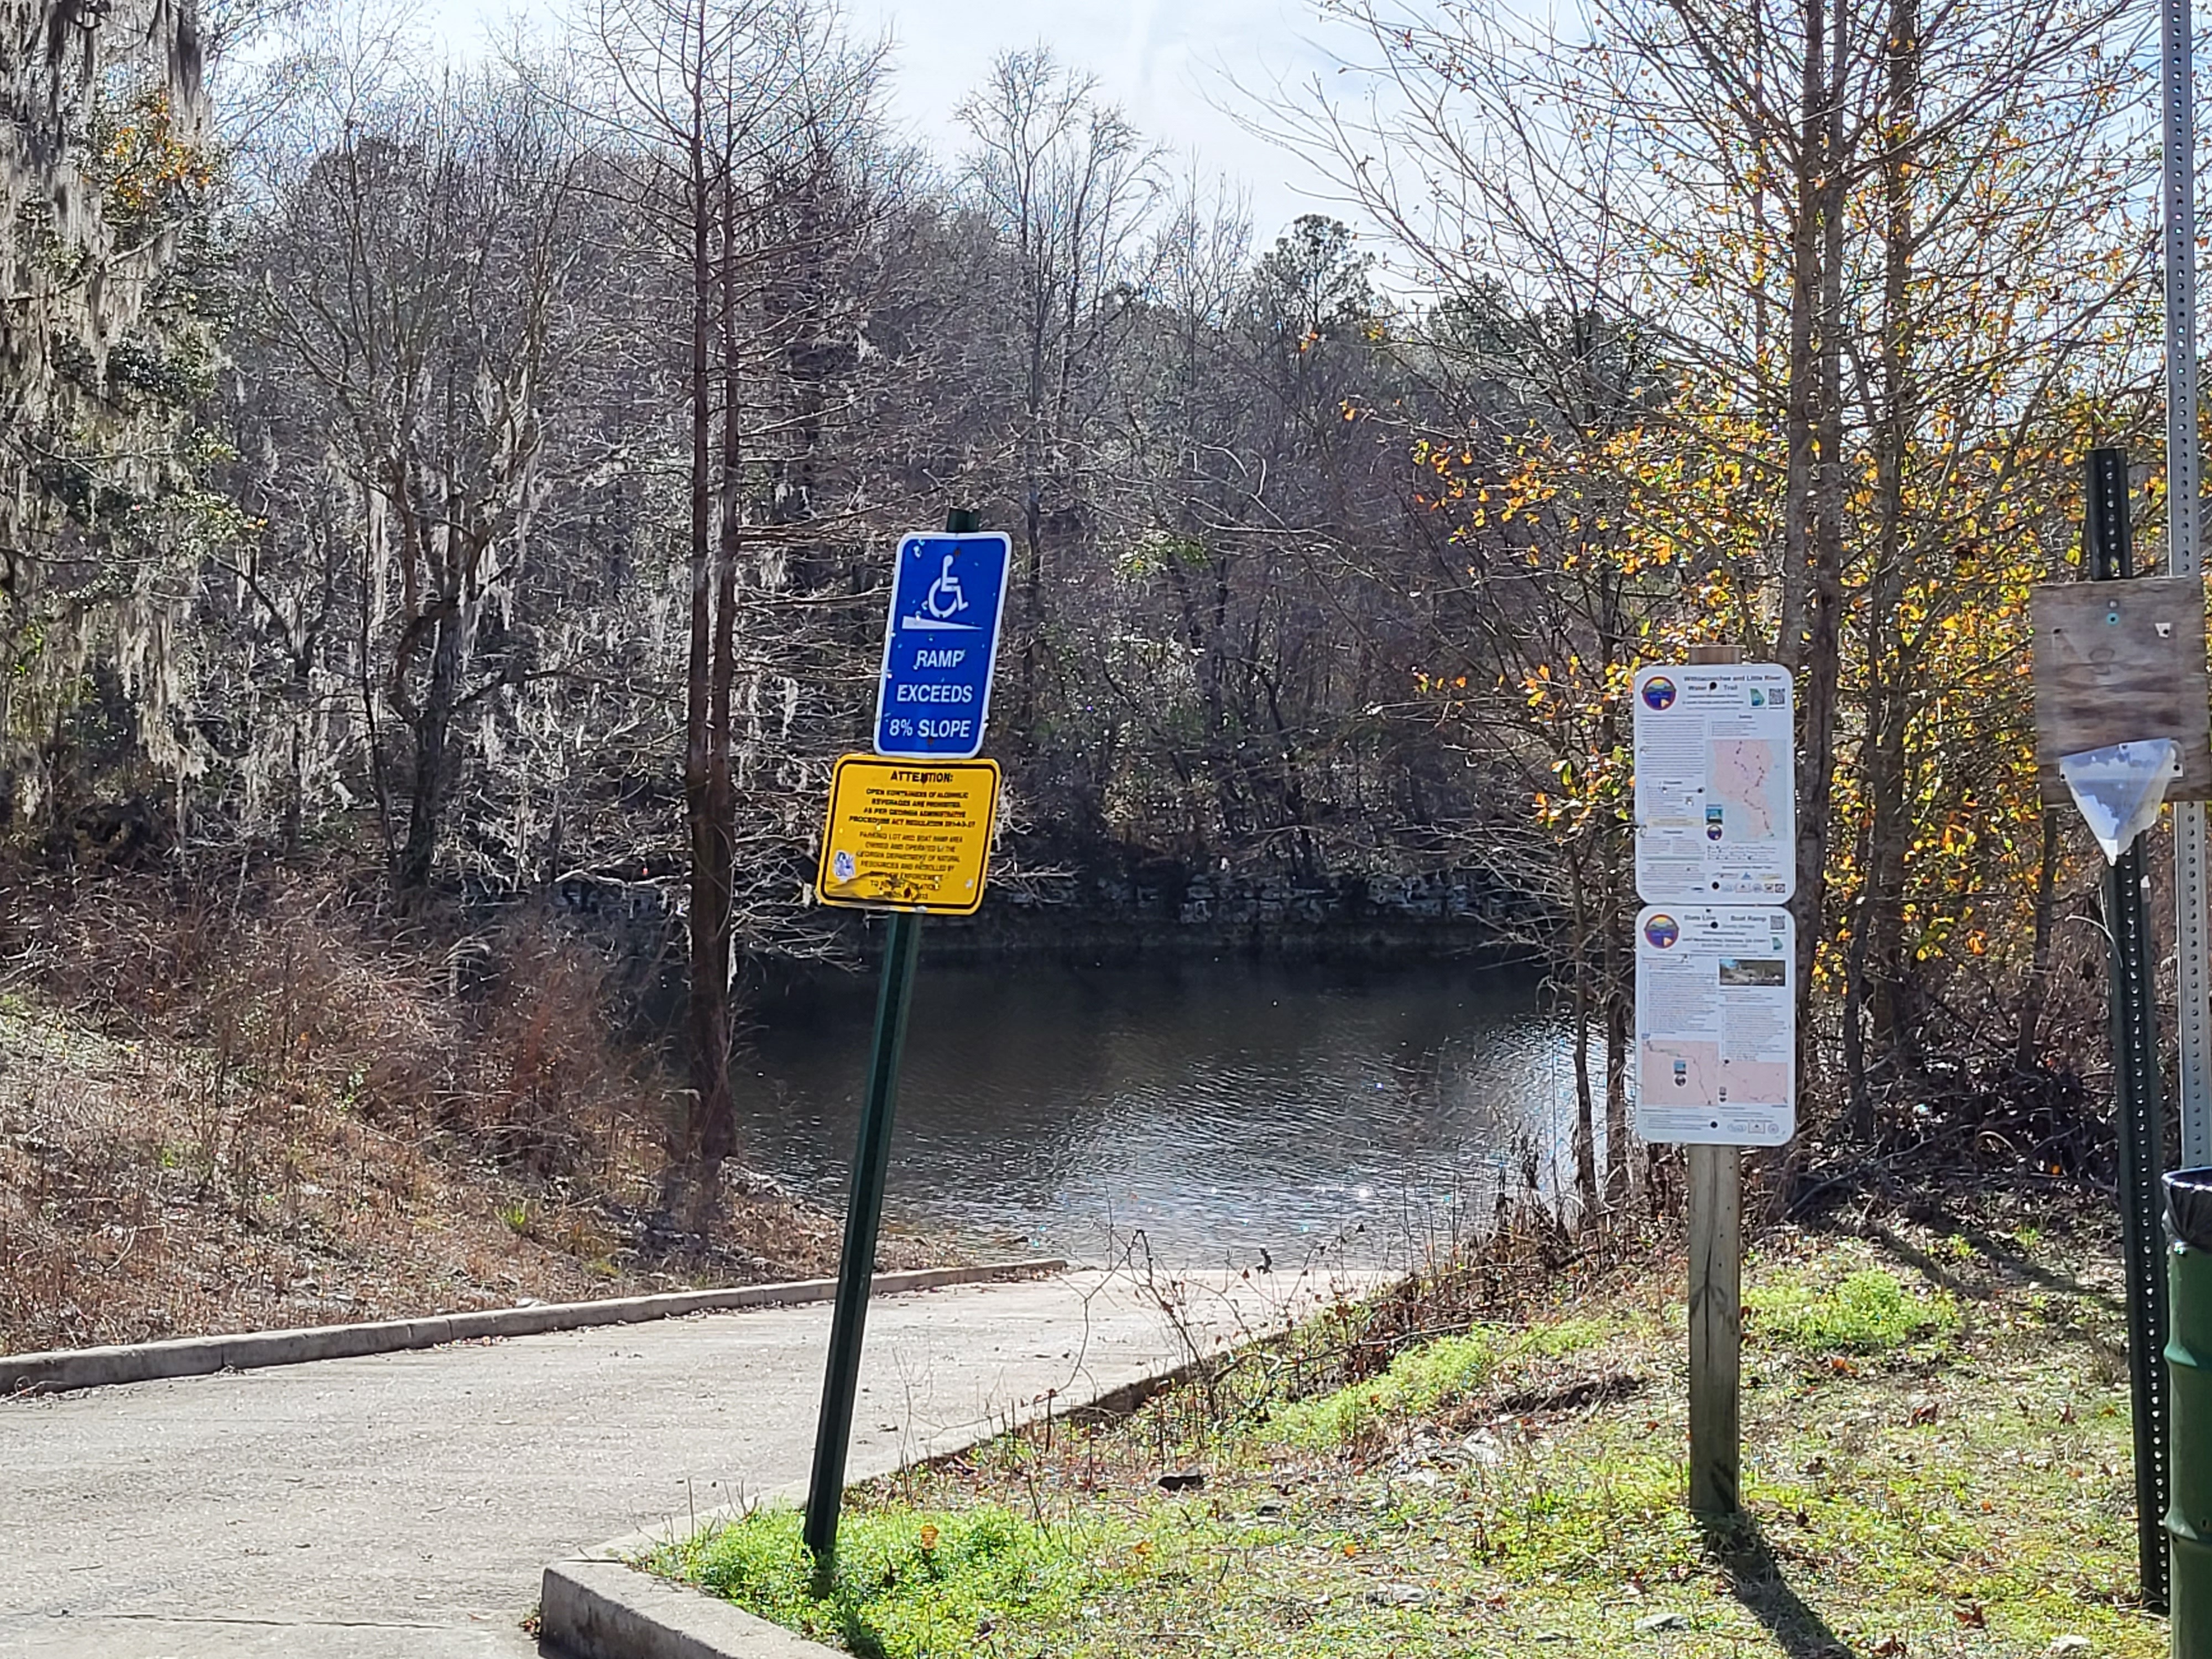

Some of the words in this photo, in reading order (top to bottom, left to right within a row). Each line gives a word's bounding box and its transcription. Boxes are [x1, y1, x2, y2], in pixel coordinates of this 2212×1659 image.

[916, 649, 964, 667] RAMP
[897, 684, 973, 703] EXCEEDS
[889, 719, 913, 737] 8%
[917, 719, 971, 738] SLOPE
[890, 770, 953, 782] ATTENTION:
[872, 798, 910, 806] BEVERAGES
[859, 831, 887, 839] PARKING
[886, 852, 927, 860] DEPARTMENT
[860, 860, 899, 869] RESOURCES
